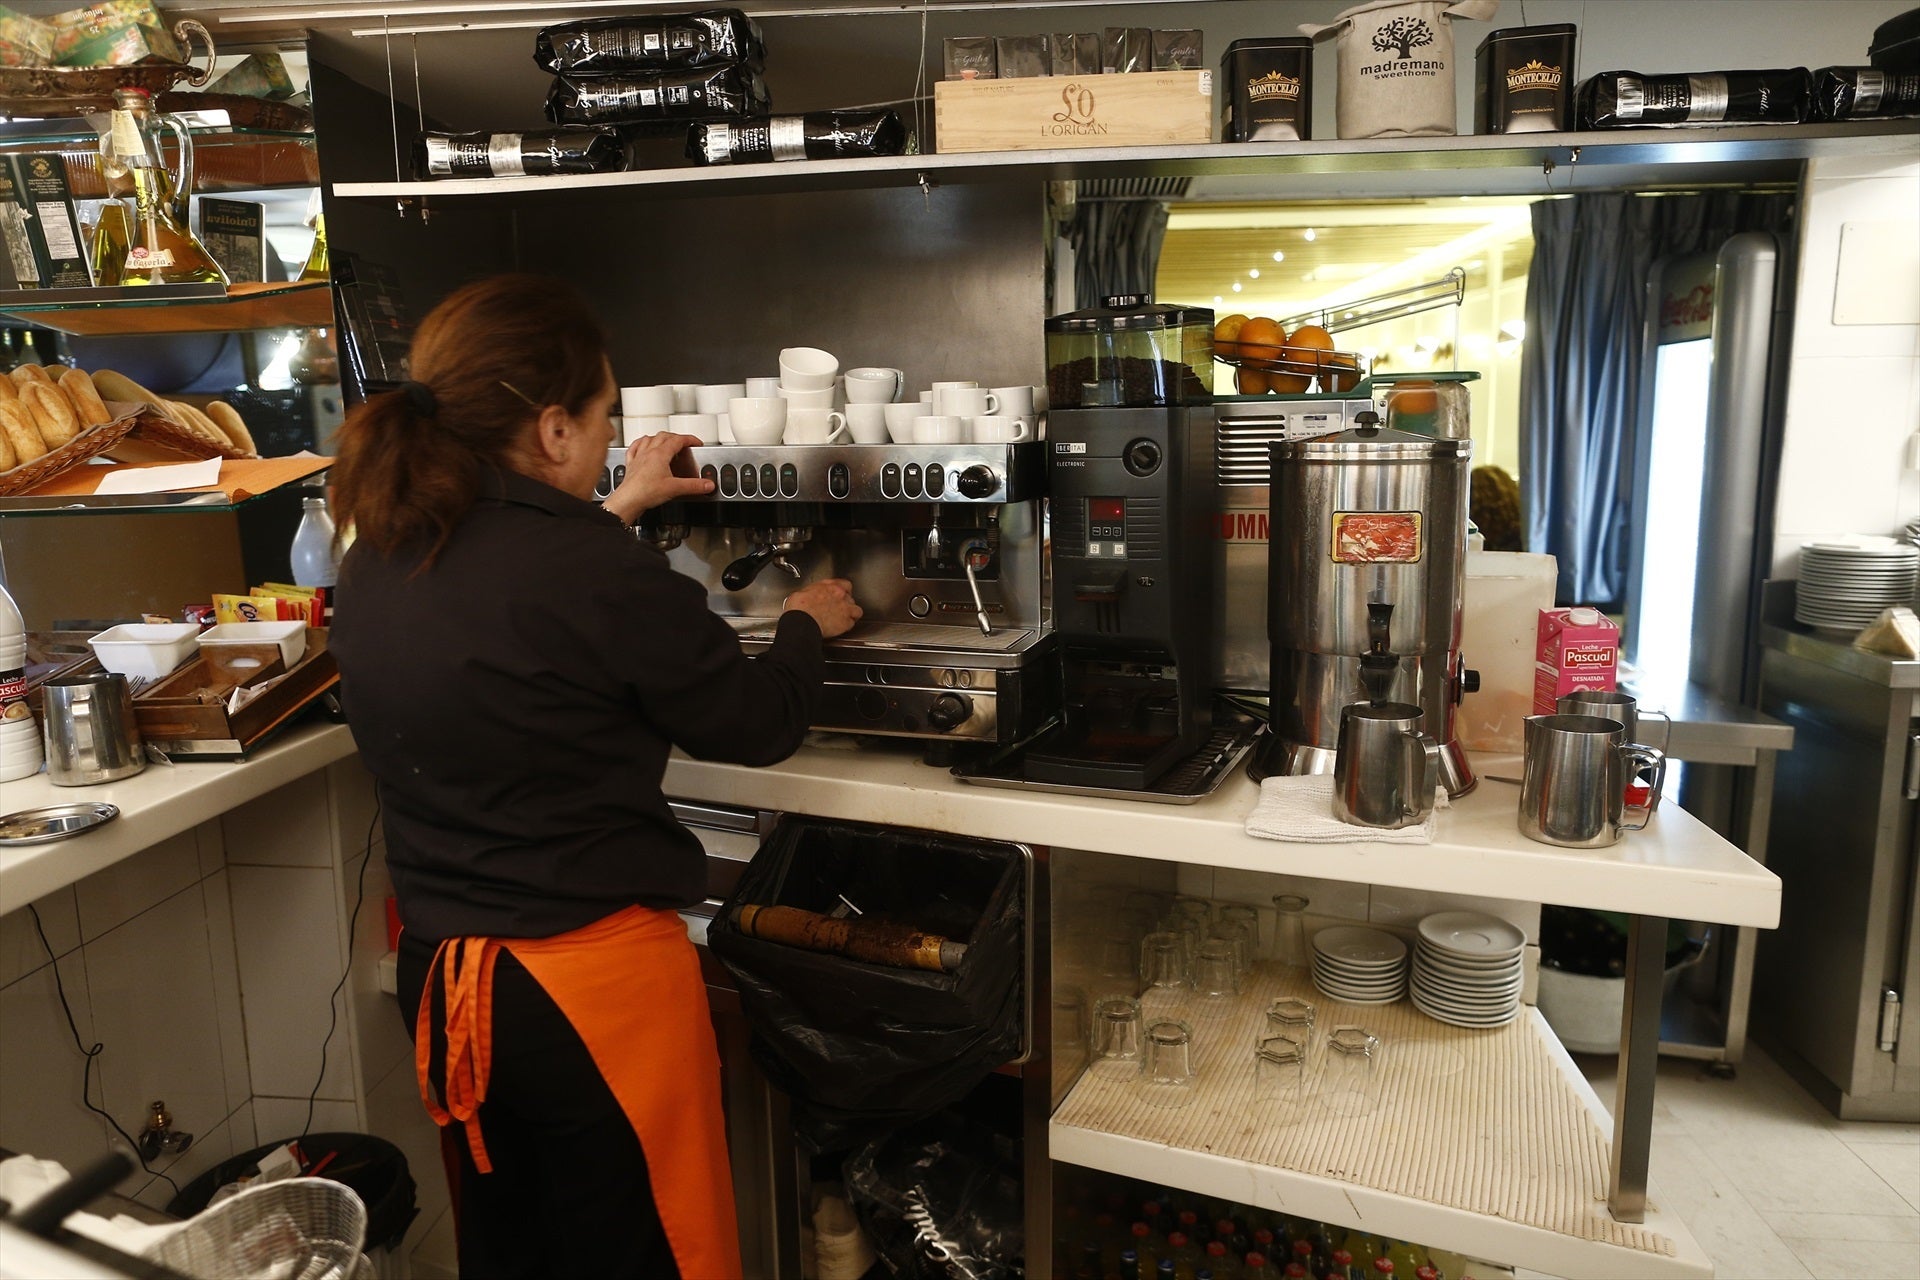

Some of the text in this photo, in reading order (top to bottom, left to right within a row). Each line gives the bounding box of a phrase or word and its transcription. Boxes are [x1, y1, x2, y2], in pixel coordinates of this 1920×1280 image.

[73, 8, 104, 21] Infusion
[89, 24, 101, 34] 25
[1360, 60, 1445, 76] madremano
[1374, 70, 1436, 80] sweethome
[1507, 72, 1561, 87] MONTECELIO
[1248, 83, 1300, 97] MONTECELIO
[1041, 122, 1108, 137] L'ORIGAN
[1056, 443, 1086, 453] IBERITAL
[1567, 650, 1610, 663] Pascual
[2, 676, 19, 684] Leche
